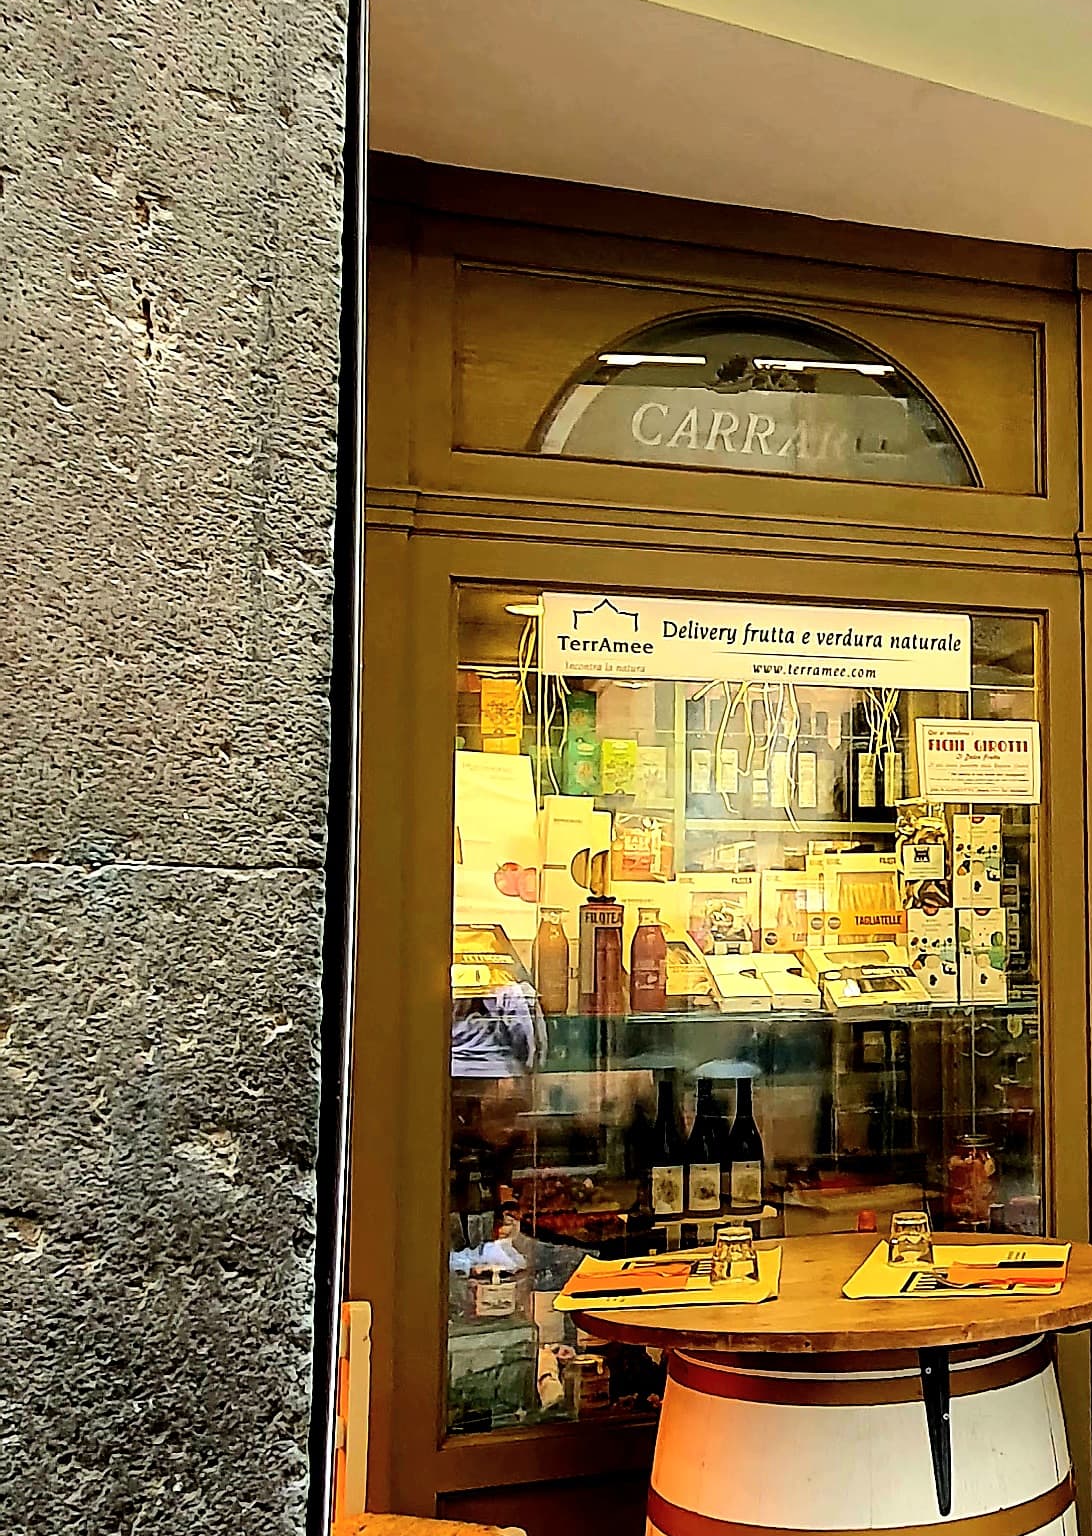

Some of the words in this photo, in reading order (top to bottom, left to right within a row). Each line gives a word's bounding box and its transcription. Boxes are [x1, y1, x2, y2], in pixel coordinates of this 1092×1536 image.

[557, 635, 654, 654] TerrAmee
[663, 620, 737, 645] Delivery
[742, 622, 795, 645] frutta
[801, 630, 811, 644] e
[816, 628, 883, 648] verdura
[890, 633, 962, 652] naturale
[752, 663, 877, 680] www.terramee.com
[974, 740, 1028, 753] GIROTTI
[855, 915, 902, 926] TAGLIATELLE
